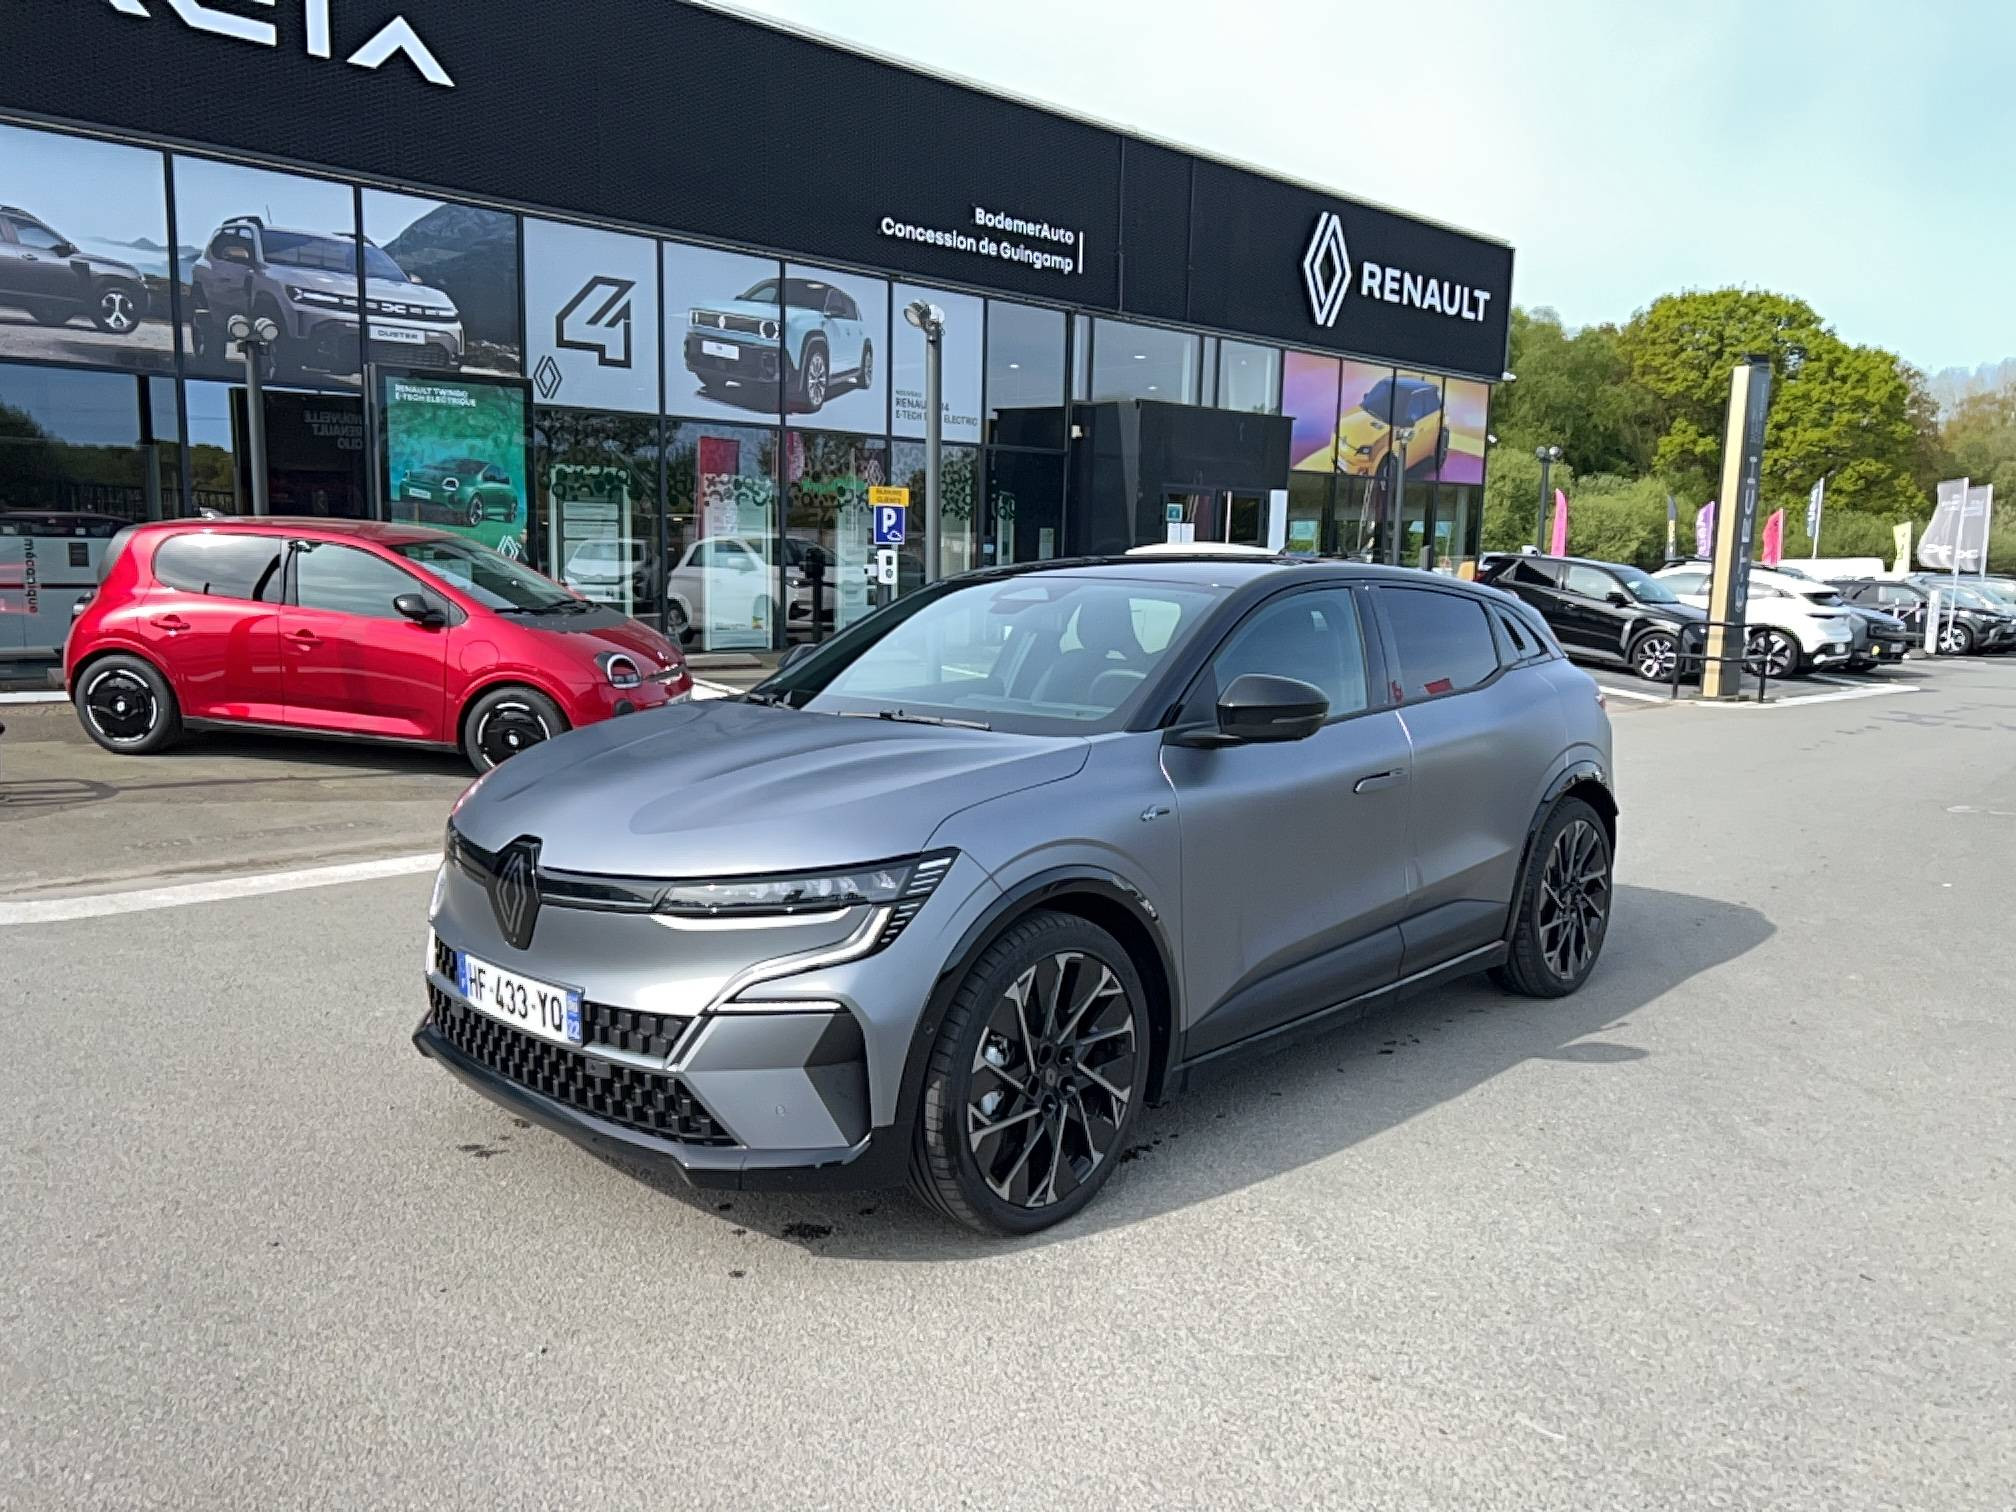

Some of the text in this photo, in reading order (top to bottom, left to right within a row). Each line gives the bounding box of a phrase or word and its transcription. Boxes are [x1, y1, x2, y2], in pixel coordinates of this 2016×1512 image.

[974, 206, 1075, 245] BodemerAuto
[880, 216, 1074, 275] Concession de Guingamp
[1360, 261, 1492, 322] RENAULT
[395, 384, 433, 394] RENAULT
[895, 409, 922, 421] E-TECH
[944, 414, 978, 427] ELECTRIC
[882, 507, 897, 533] P
